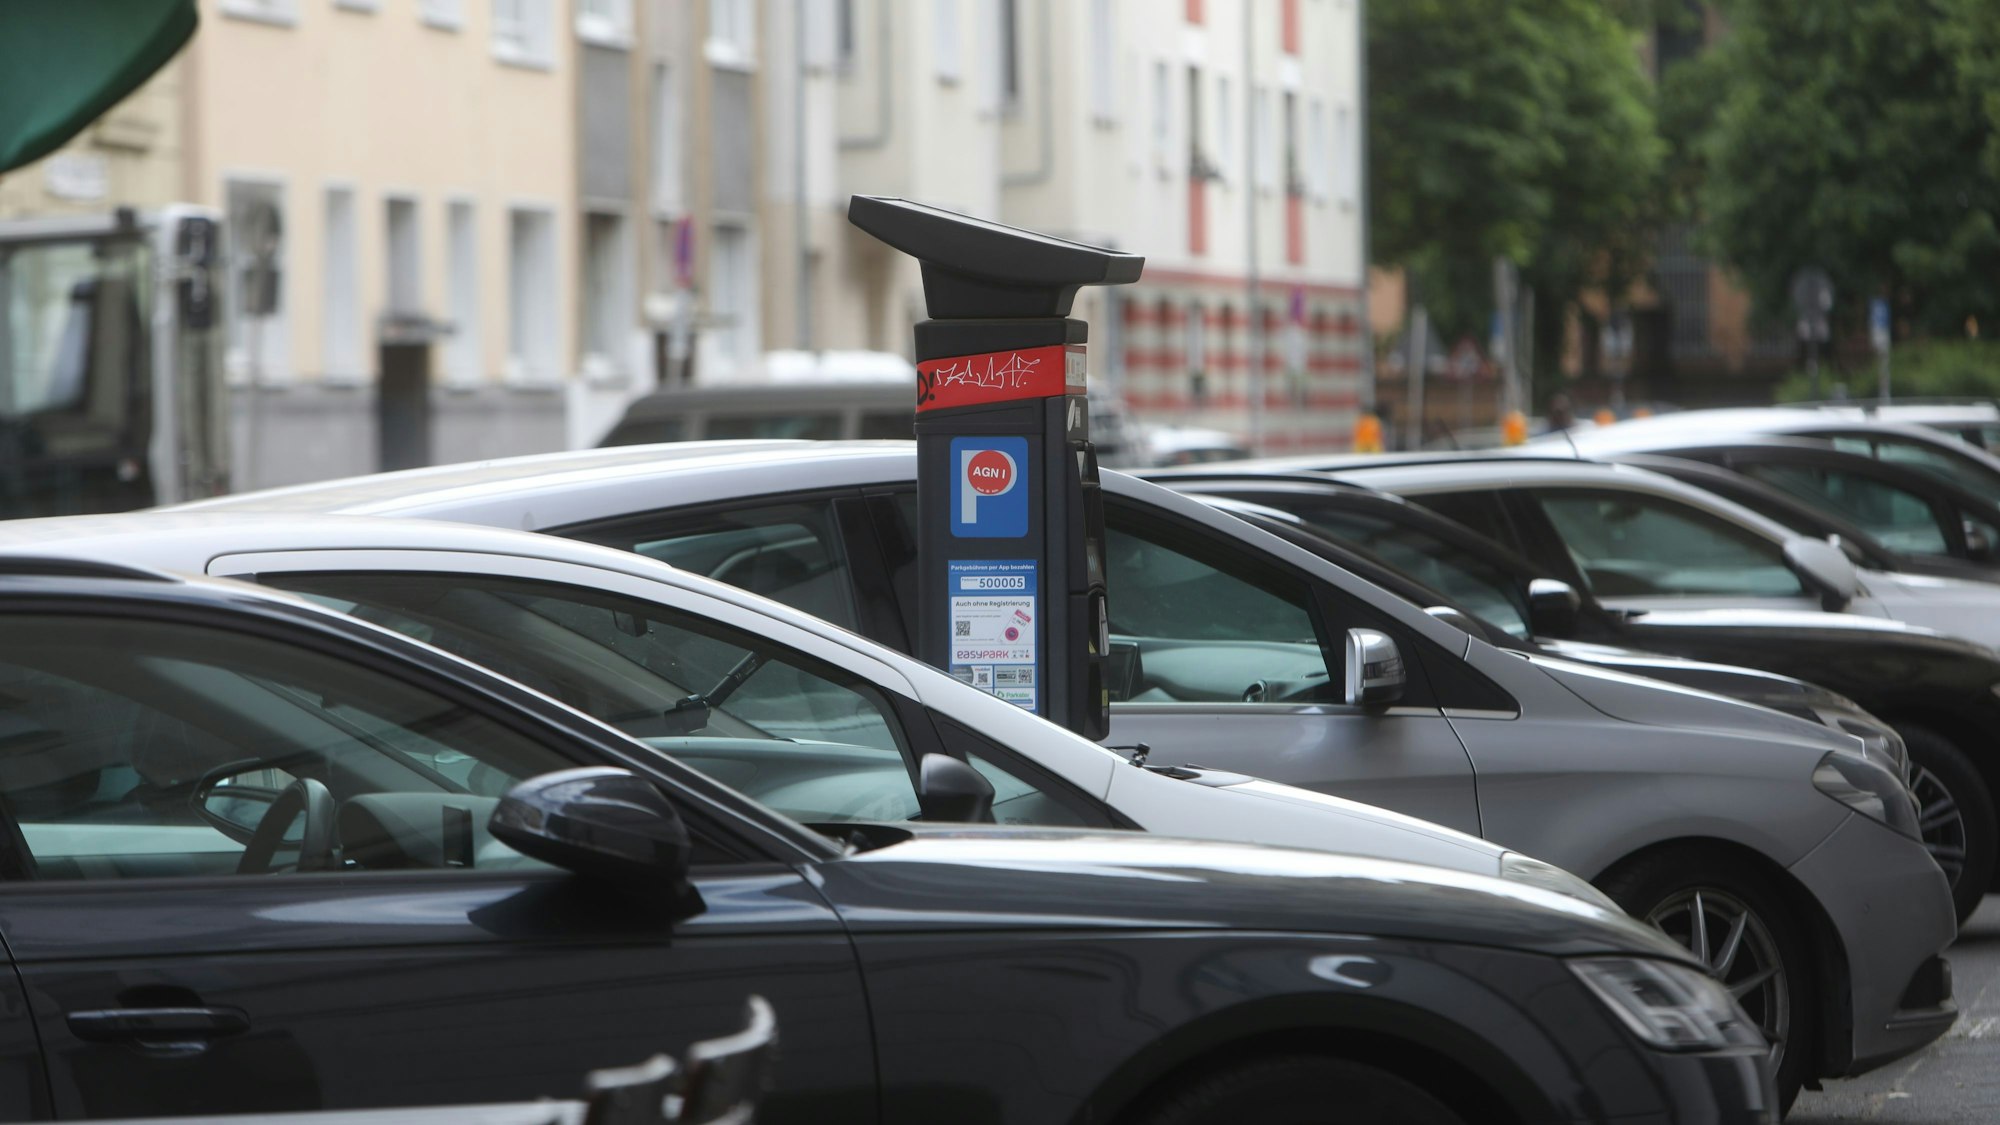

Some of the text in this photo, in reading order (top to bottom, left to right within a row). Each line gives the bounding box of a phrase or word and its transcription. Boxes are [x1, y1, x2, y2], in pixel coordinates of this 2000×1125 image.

[972, 466, 1000, 478] AGN
[961, 450, 1018, 524] P
[979, 578, 1023, 588] 500005
